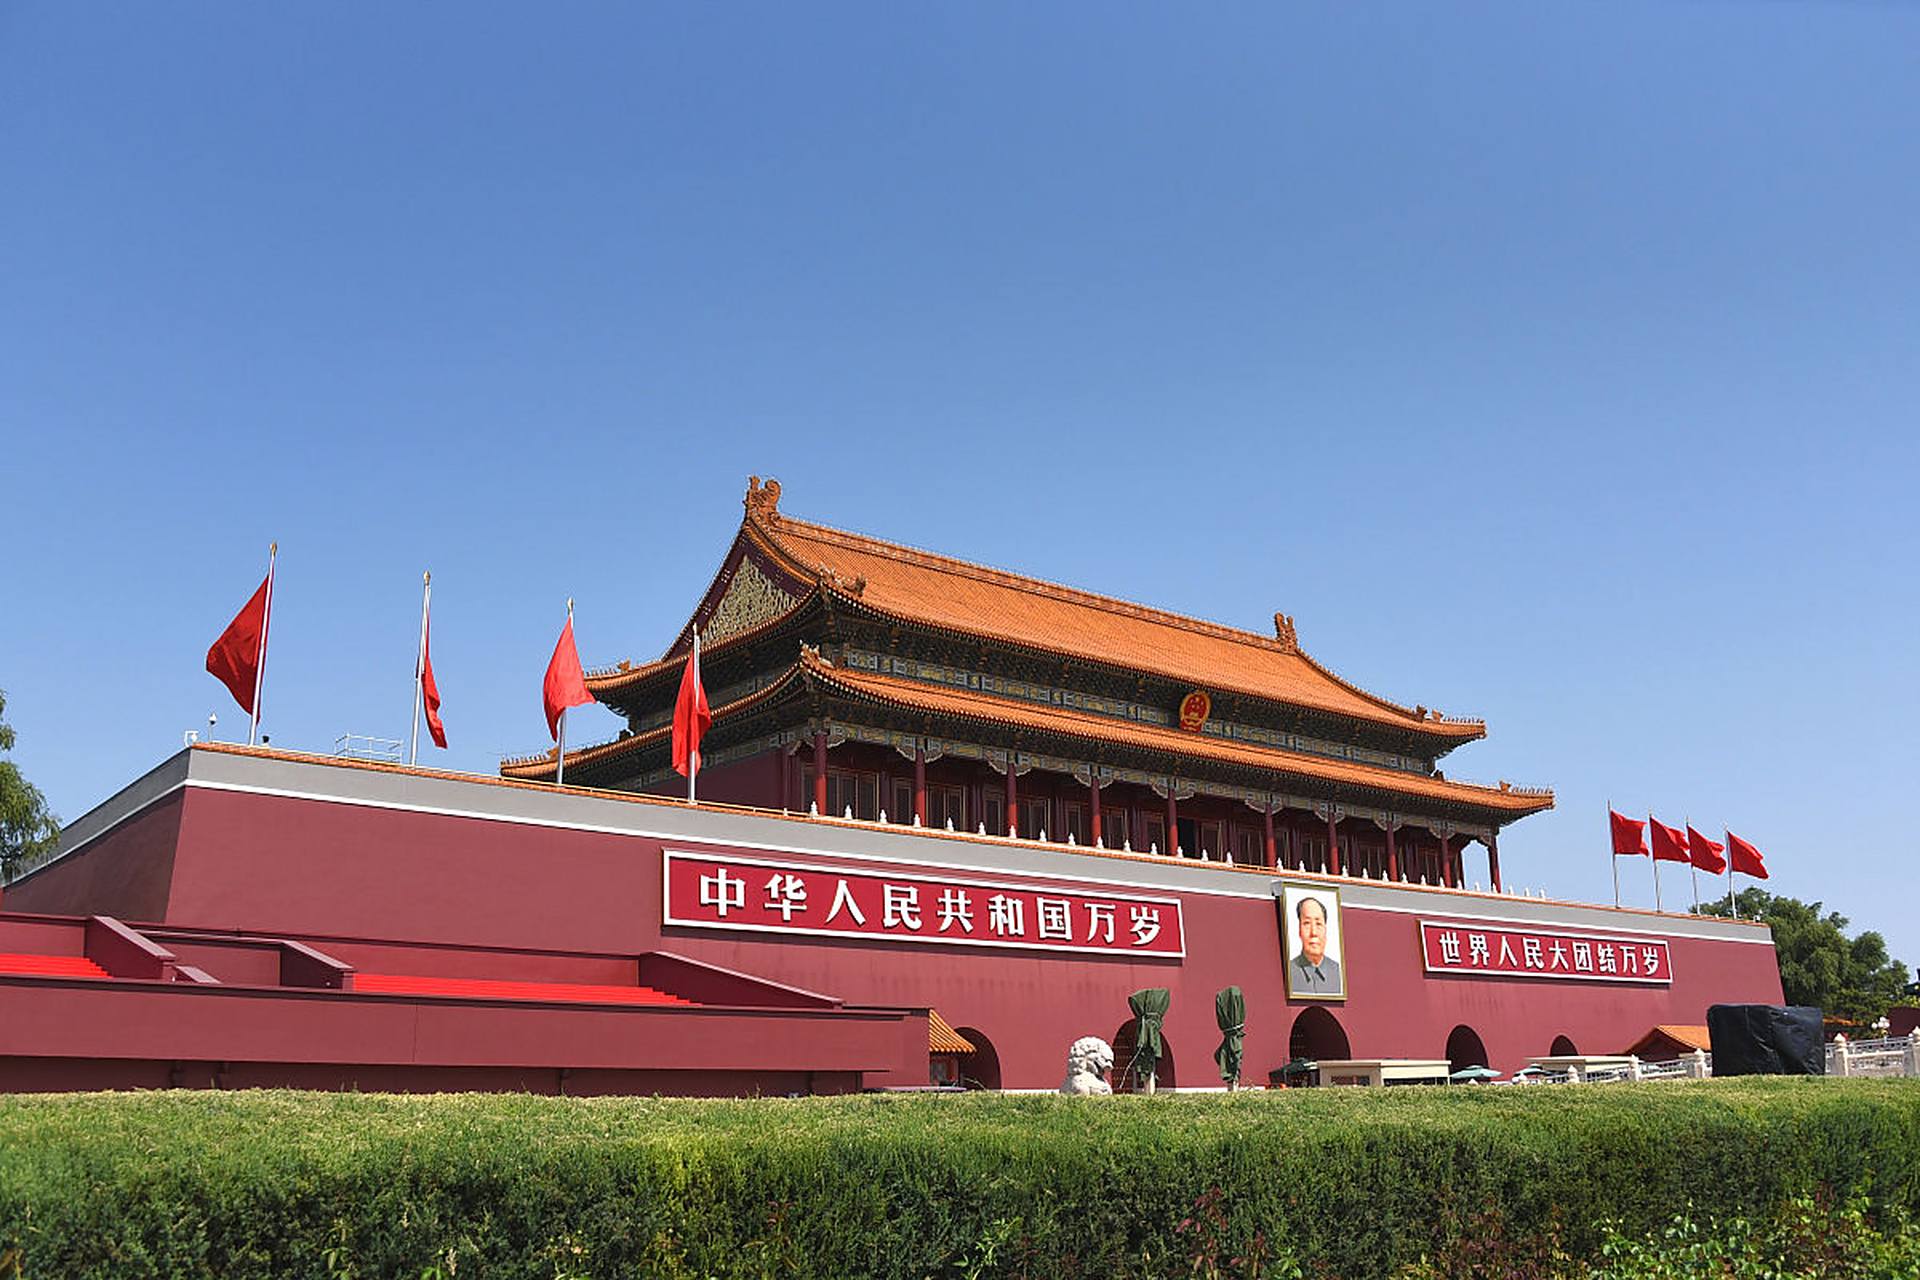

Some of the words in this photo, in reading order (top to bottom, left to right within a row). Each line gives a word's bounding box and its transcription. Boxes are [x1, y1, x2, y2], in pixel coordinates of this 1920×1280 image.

[699, 867, 1161, 945] 中华人民共和国万岁
[1439, 930, 1660, 975] 世界人民大团结万岁
